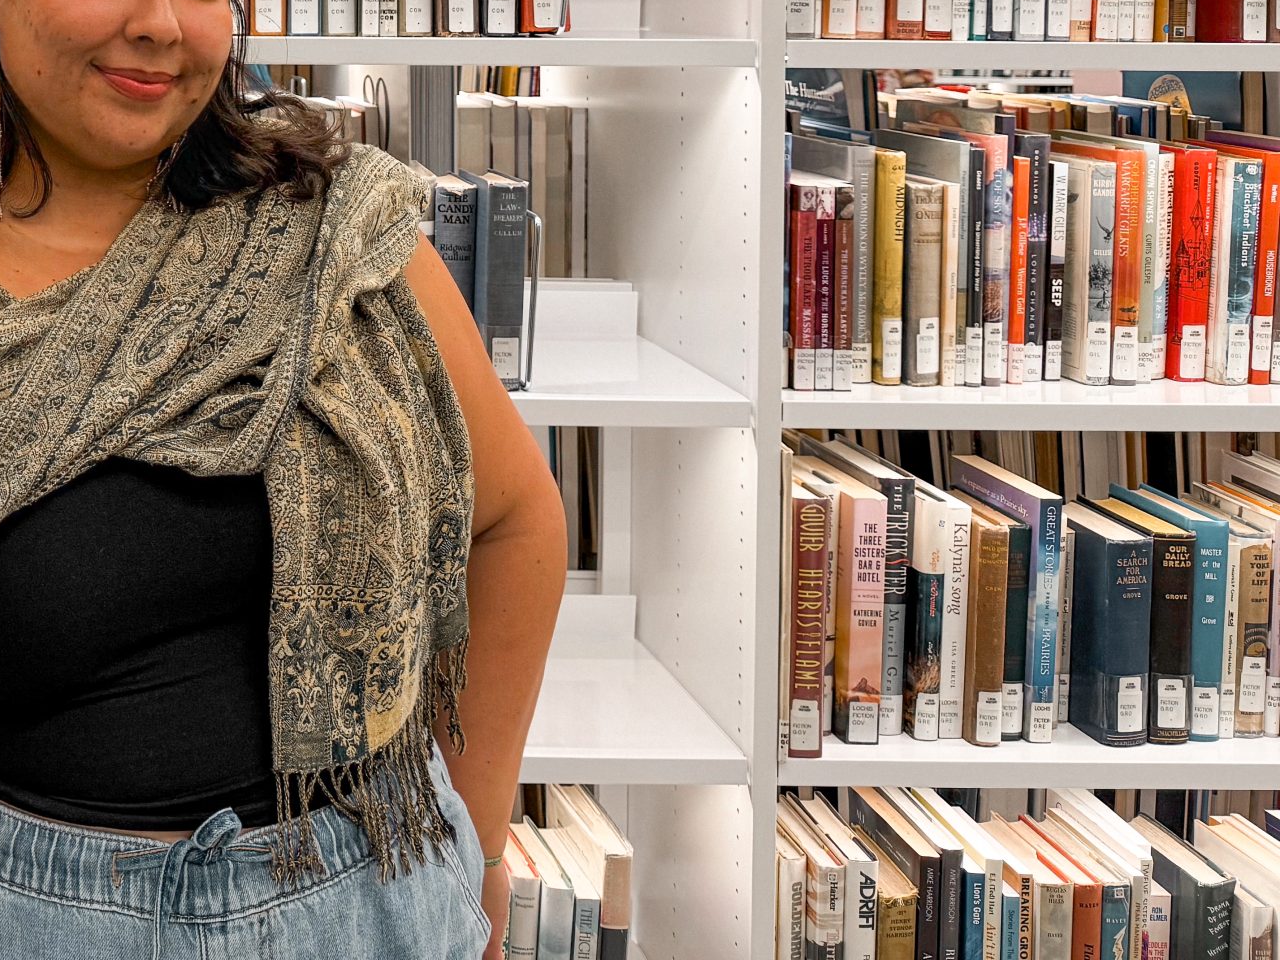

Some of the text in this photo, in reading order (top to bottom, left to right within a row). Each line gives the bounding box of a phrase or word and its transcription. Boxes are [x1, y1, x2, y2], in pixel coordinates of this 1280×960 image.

[438, 204, 475, 213] CANDY
[1146, 191, 1154, 223] SHYNESS
[894, 186, 904, 241] MIDNIGHT
[443, 215, 470, 224] MAN
[1241, 183, 1254, 267] Blackfoot Indians
[440, 244, 472, 254] Ridgwell
[1264, 250, 1275, 297] HOUSEBROKEN
[1051, 279, 1063, 307] SEEP
[864, 523, 877, 533] THE
[859, 535, 882, 545] THREE
[884, 485, 909, 595] THE TRICKSTER
[854, 548, 885, 558] SISTERS
[1200, 548, 1222, 556] MASTER
[1116, 558, 1148, 567] SEARCH
[947, 524, 968, 615] Kalyna's song
[857, 572, 880, 582] HOTEL
[1116, 576, 1147, 584] AMERICA
[795, 503, 825, 689] GOVIER HEARTS FLAME
[853, 609, 882, 617] KATHERINE
[858, 619, 877, 627] GOVIER
[885, 608, 900, 658] Muriel
[858, 870, 875, 930] ADRIFT
[925, 886, 934, 922] HARRISON
[1020, 877, 1030, 932] BREAKING
[1152, 907, 1163, 915] RON
